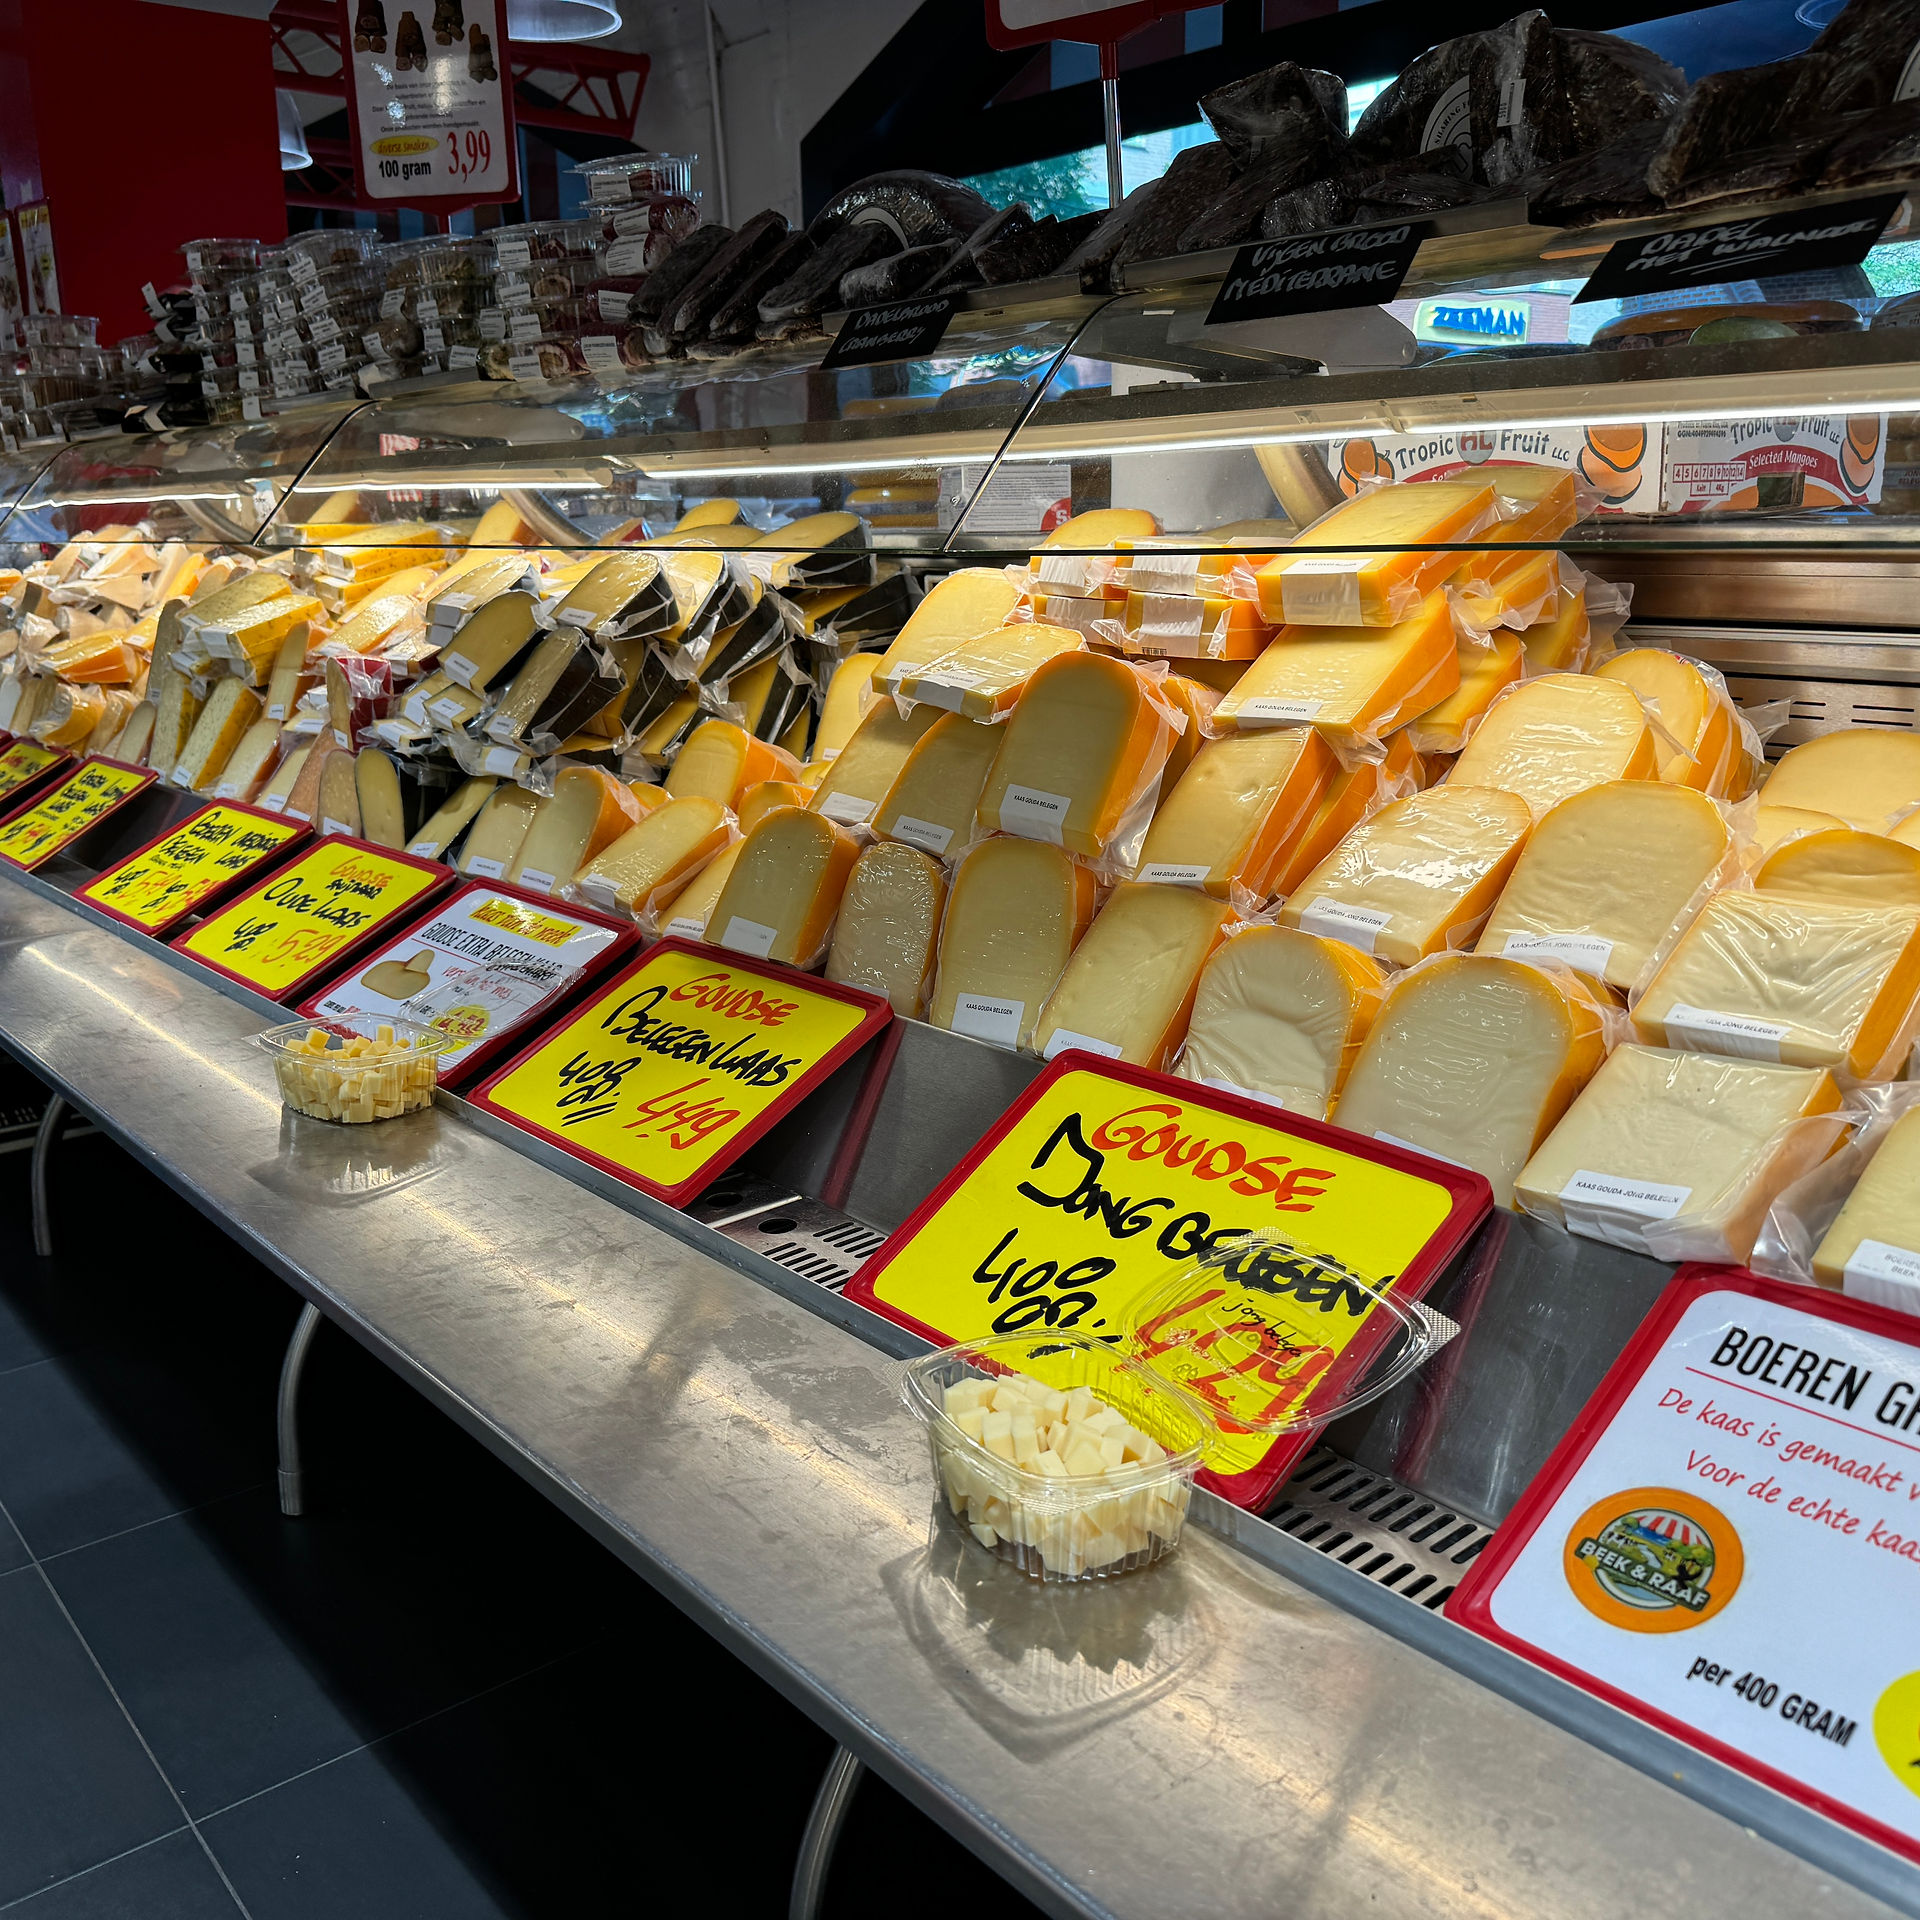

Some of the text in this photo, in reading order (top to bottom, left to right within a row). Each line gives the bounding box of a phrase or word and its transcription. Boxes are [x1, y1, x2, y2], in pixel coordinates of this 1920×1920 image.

[379, 160, 431, 180] 100 gram
[447, 130, 491, 184] 3,99
[1330, 226, 1412, 252] BROOD
[1433, 306, 1526, 337] ZEEMAN
[1730, 417, 1773, 444] Tropic
[1395, 434, 1454, 471] Tropic
[1500, 430, 1551, 456] Fruit
[1552, 447, 1570, 463] LLC
[1749, 450, 1819, 470] Selected Mangoes
[1025, 797, 1040, 806] GOUDA
[1039, 800, 1059, 811] BELEGEN
[903, 825, 913, 833] KAAS
[330, 855, 394, 889] GOUDSE
[264, 877, 318, 913] OUDE
[311, 897, 372, 928] KAAS
[1327, 907, 1345, 917] GOUDA
[1345, 913, 1360, 921] JONG
[1359, 916, 1383, 926] BELEGEN
[421, 921, 463, 948] GOUDSE
[453, 932, 495, 957] EXTRA
[472, 900, 505, 924] kaas
[537, 921, 577, 945] week
[670, 973, 800, 1027] GOUDSE
[977, 1004, 992, 1012] GOUDA
[992, 1007, 1013, 1015] BELEGEN
[601, 985, 803, 1088] BELEGEN KAAS
[1743, 1023, 1779, 1035] BELEGEN
[558, 1050, 642, 1087] 400
[622, 1077, 741, 1151] 4.49
[1091, 1103, 1336, 1211] GOUDSE
[1576, 1181, 1597, 1190] KAAS
[1596, 1184, 1623, 1195] GOUDA
[1622, 1190, 1645, 1199] JONG
[1016, 1111, 1395, 1316] JONG BELEGEN
[972, 1226, 1117, 1303] 400
[1221, 1297, 1266, 1327] jong
[1710, 1326, 1872, 1412] BOEREN
[1658, 1387, 1693, 1415] De
[1696, 1400, 1755, 1437] kaas
[1757, 1422, 1782, 1448] is
[1778, 1437, 1904, 1494] gemaakt
[1686, 1450, 1746, 1487] Voor
[1747, 1476, 1783, 1504] de
[1787, 1491, 1861, 1536] echte
[1579, 1540, 1710, 1608] BEEK & RAAF
[1686, 1655, 1858, 1747] per 400 GRAM
